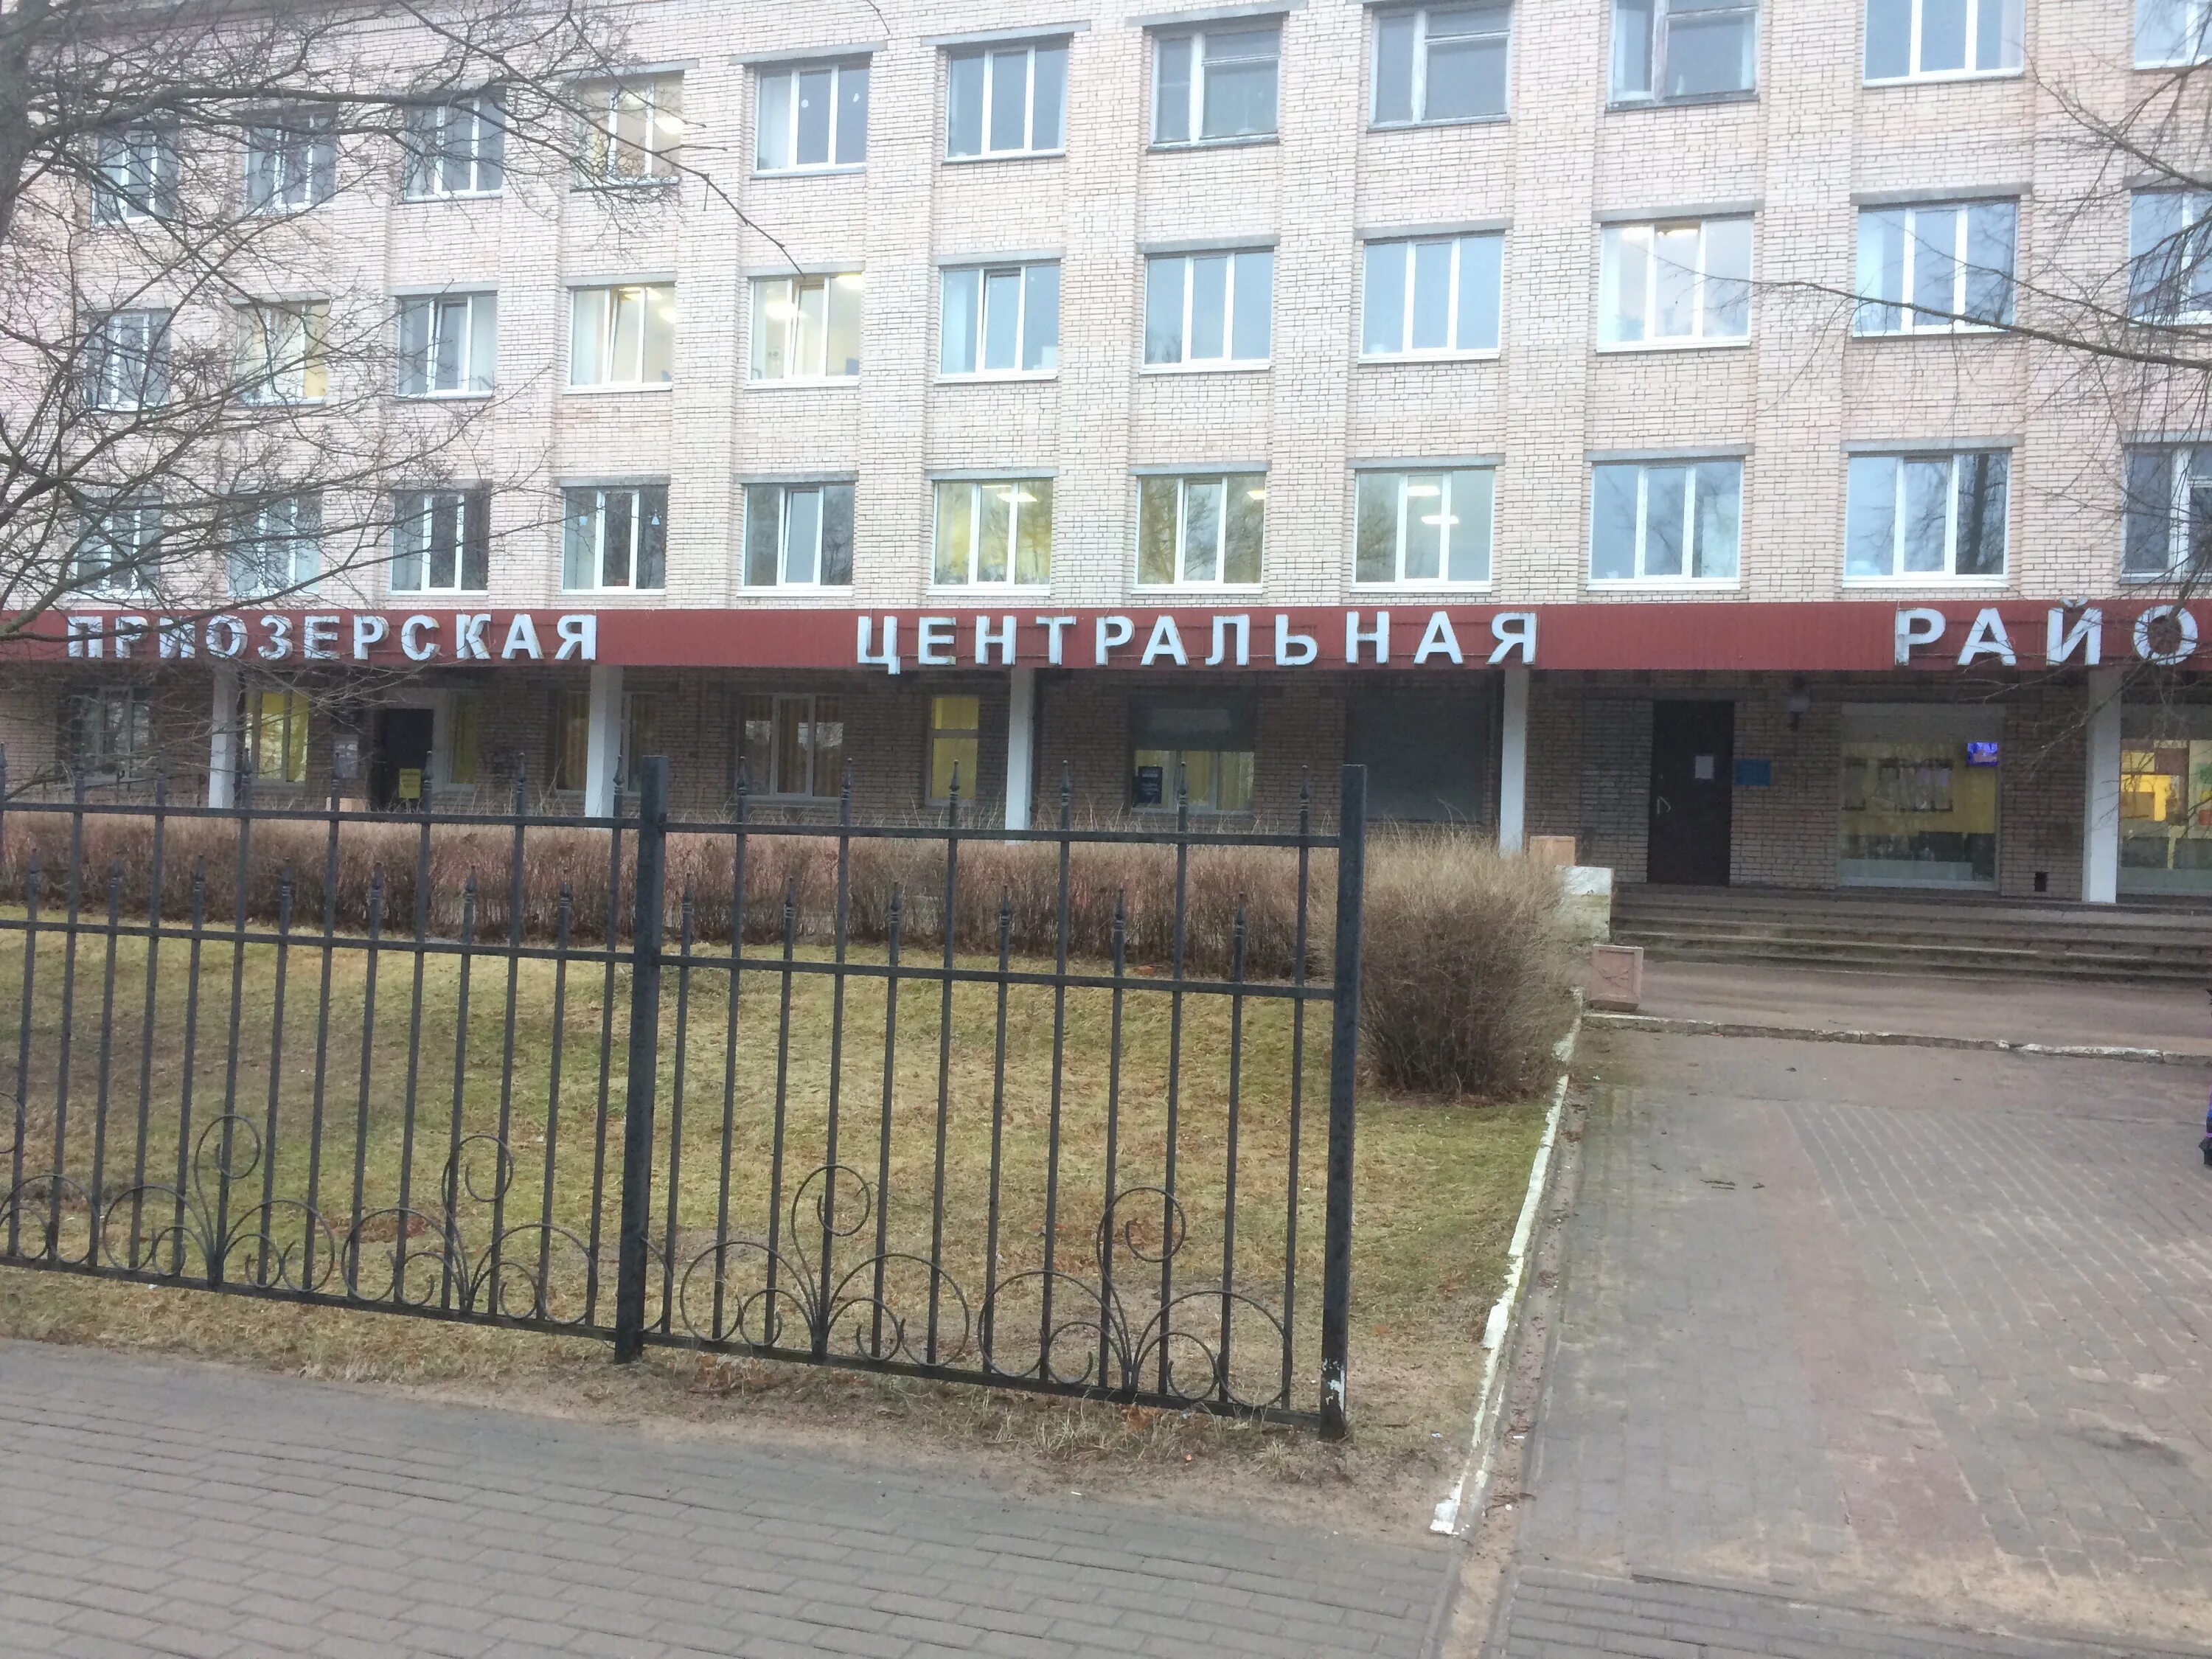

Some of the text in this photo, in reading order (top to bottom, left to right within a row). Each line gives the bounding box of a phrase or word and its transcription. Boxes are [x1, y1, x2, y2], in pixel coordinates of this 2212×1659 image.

[67, 597, 2199, 675] ПРИОЗЕРСКАЯ ЦЕНТРАЛЬНАЯ РАЙО
